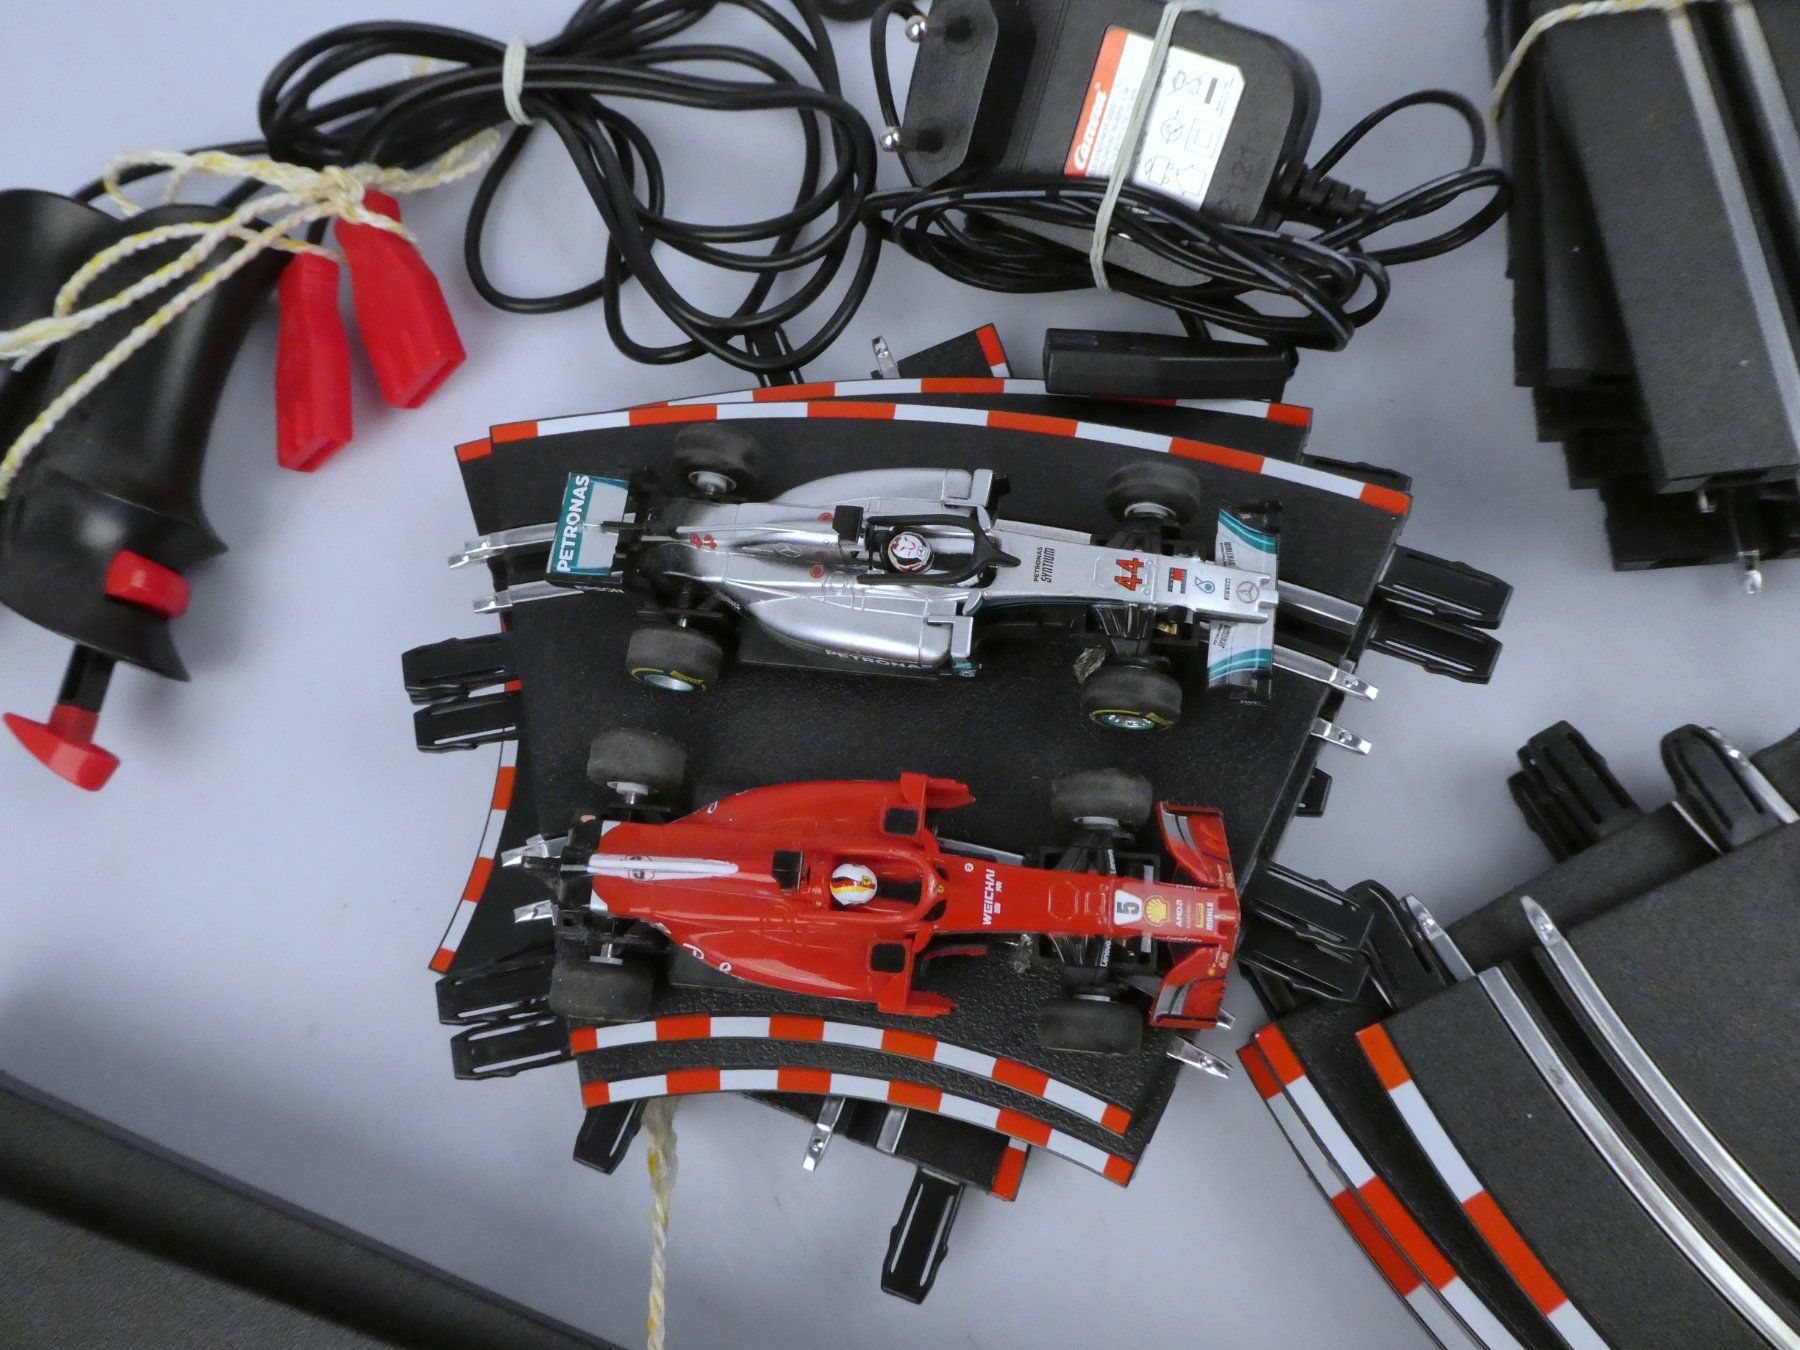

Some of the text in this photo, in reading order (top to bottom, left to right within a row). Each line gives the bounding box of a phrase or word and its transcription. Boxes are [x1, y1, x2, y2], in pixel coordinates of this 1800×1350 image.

[557, 475, 590, 572] PETRONAS
[1033, 546, 1043, 582] PETRONAS
[1114, 557, 1145, 592] 44
[982, 868, 996, 926] WEICHAI
[1116, 900, 1140, 917] 5
